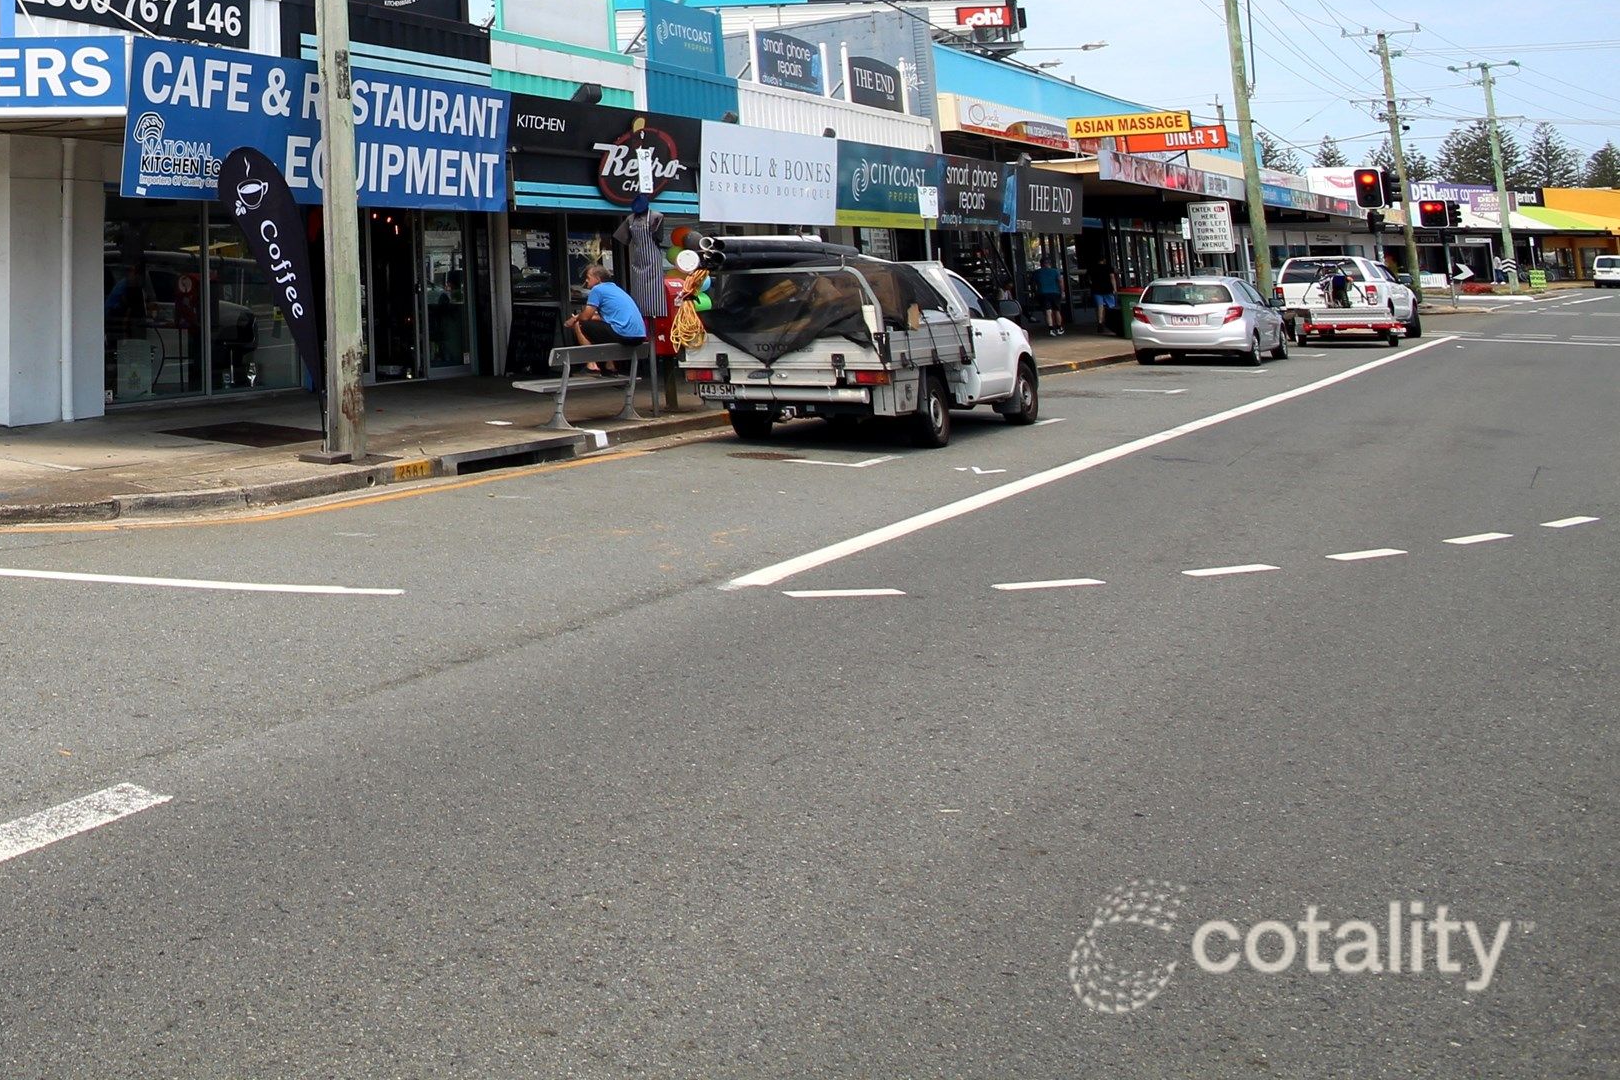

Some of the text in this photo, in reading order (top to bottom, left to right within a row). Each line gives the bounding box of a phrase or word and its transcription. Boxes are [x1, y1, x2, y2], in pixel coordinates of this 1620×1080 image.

[669, 21, 712, 45] CITYCOAST
[684, 41, 714, 54] PROPERTY
[763, 37, 811, 61] smart phone
[777, 59, 803, 78] repairs
[854, 66, 873, 89] THE
[875, 71, 895, 94] END
[142, 51, 503, 140] CAFE & RSTAURANT
[516, 113, 565, 132] KITCHEN
[1074, 114, 1183, 134] ASIAN MASSAGE
[142, 139, 213, 159] NATIONAL
[1165, 131, 1205, 147] DINER
[140, 156, 200, 176] KITCHEN
[593, 142, 687, 179] Rero
[710, 151, 831, 184] SKULL & BONES
[139, 174, 171, 187] Importers
[172, 176, 181, 186] Of
[182, 177, 204, 189] Quality
[870, 162, 926, 188] CITYCOAST
[946, 163, 998, 190] smart phone
[622, 180, 639, 192] CH
[709, 181, 830, 200] ESPRESSO BOUTIQUE
[1410, 183, 1436, 201] DEN
[888, 190, 919, 203] PROPER
[958, 190, 985, 214] repairs
[1029, 184, 1073, 214] THE END
[260, 219, 306, 320] Coffee
[755, 343, 788, 352] TOYO
